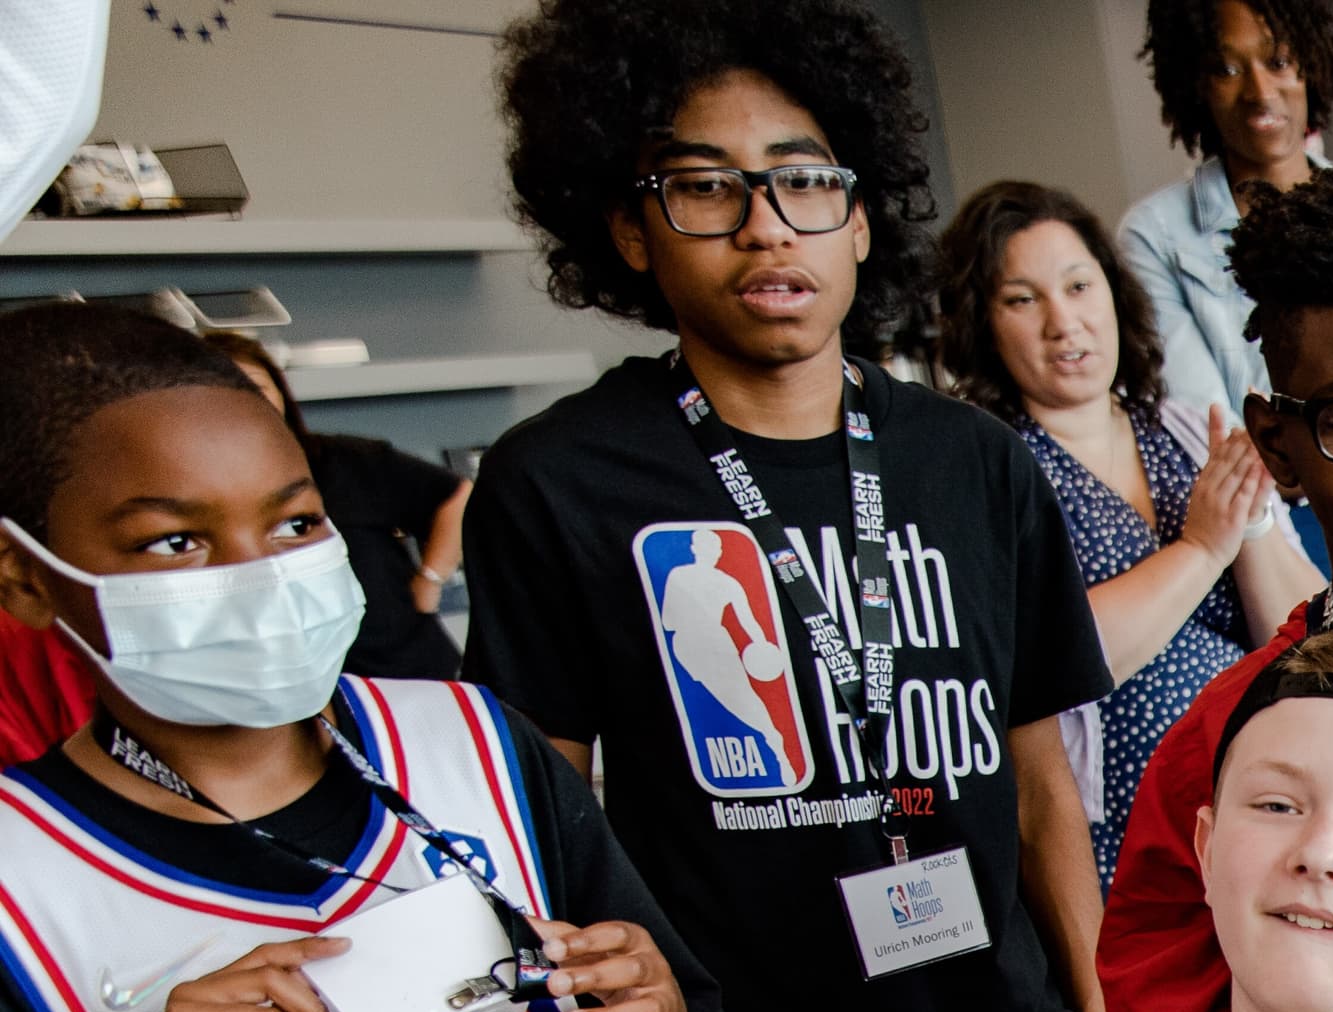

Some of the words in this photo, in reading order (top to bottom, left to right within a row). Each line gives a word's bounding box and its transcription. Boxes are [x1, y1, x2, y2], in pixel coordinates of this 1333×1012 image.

[710, 454, 758, 520] FRESH
[724, 448, 772, 517] LEARN
[852, 471, 872, 542] LEARN
[867, 473, 887, 544] FRESH
[804, 616, 850, 685] FRESH
[817, 612, 862, 682] LEARN
[865, 641, 880, 714] LEARN
[876, 643, 894, 715] FRESH
[705, 736, 768, 778] NBA
[712, 797, 787, 830] National
[906, 878, 933, 900] Math
[911, 897, 943, 920] Hoops
[874, 941, 910, 958] Ulrich
[912, 926, 960, 947] Mooring
